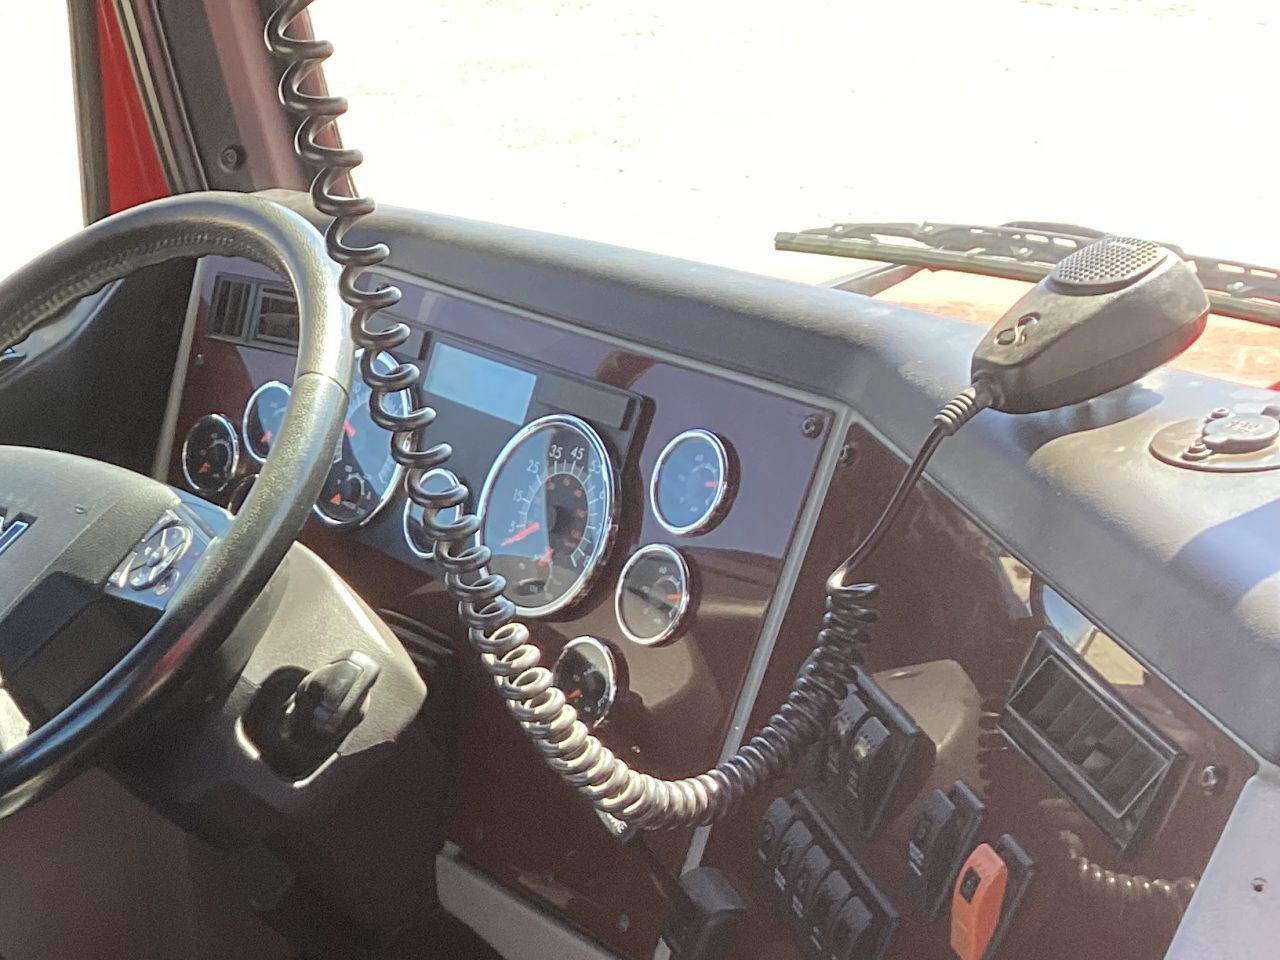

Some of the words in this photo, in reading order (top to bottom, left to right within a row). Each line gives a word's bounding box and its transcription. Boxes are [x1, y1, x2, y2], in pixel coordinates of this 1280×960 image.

[549, 445, 563, 459] 35
[570, 446, 585, 460] 45
[526, 459, 540, 474] 25
